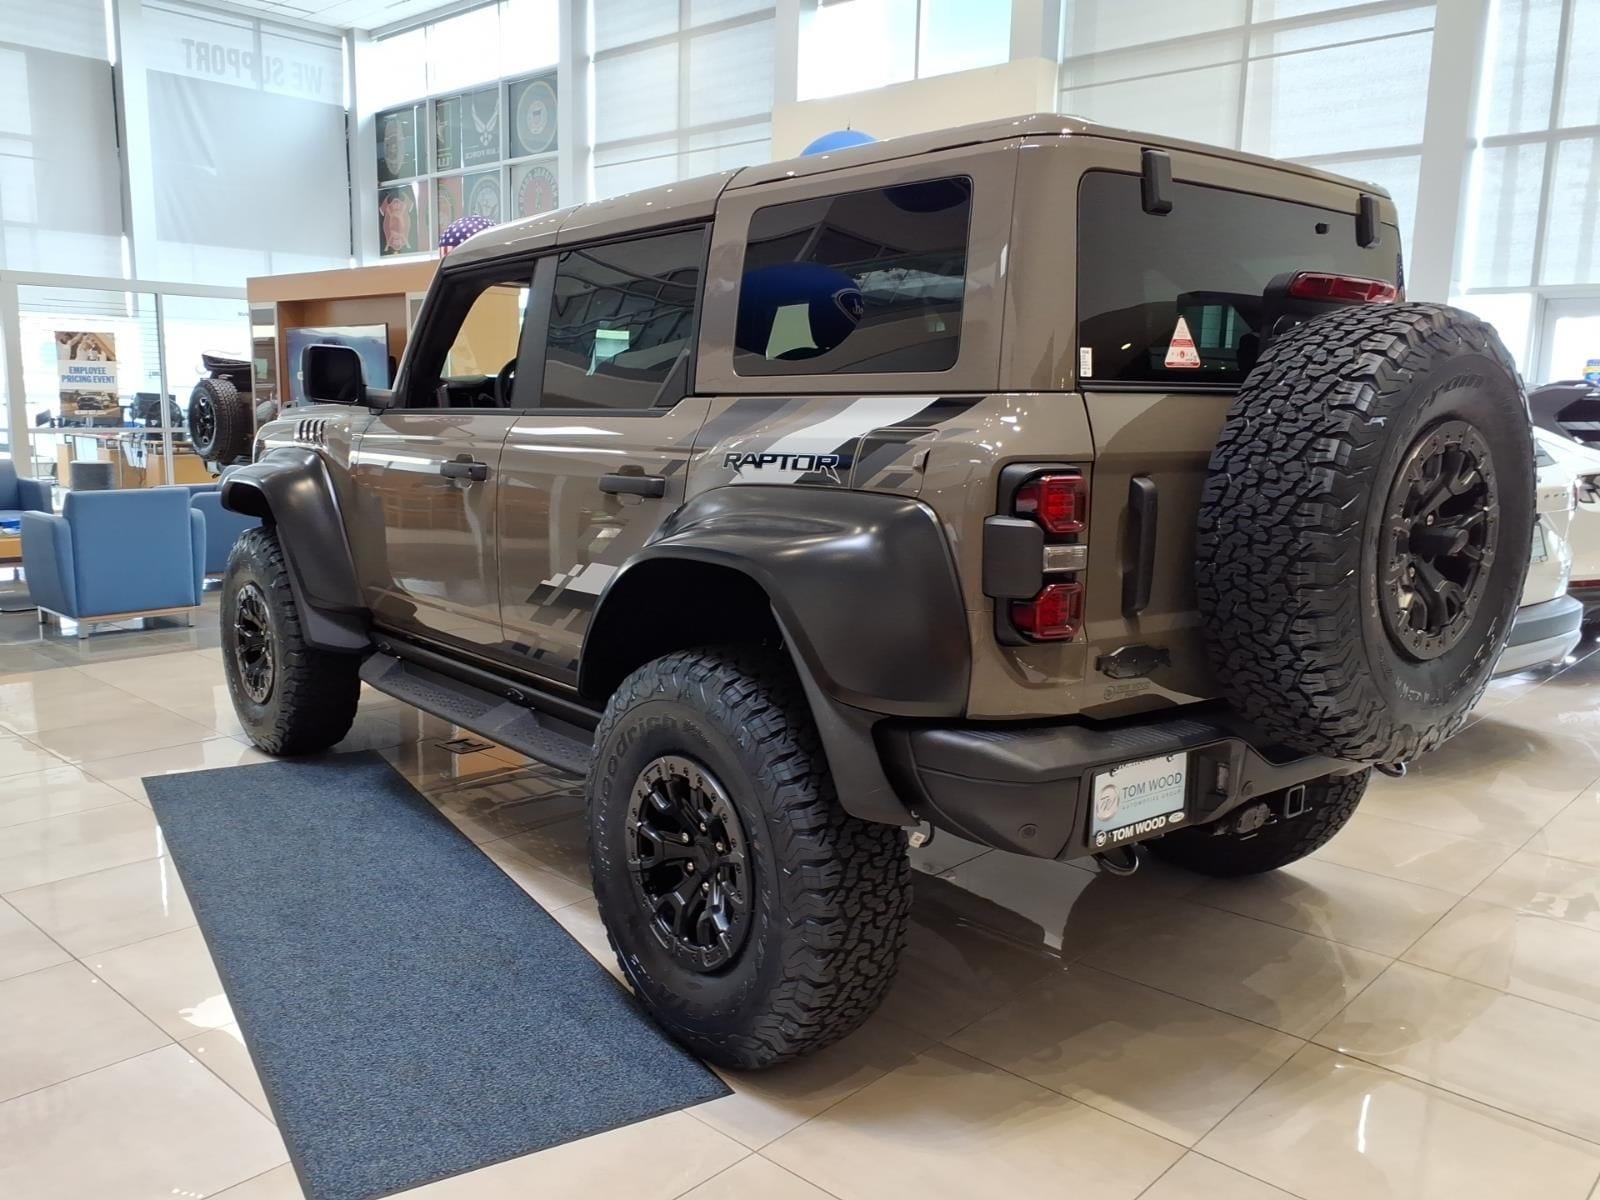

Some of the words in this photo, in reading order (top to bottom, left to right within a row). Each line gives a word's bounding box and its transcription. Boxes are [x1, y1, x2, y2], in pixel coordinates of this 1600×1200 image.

[61, 375, 93, 383] PRICING
[93, 375, 115, 384] EVENT
[68, 366, 107, 375] EMPLOYEE
[723, 452, 841, 484] RAPTOR
[1121, 781, 1146, 800] TOM
[1148, 772, 1183, 792] WOOD
[1111, 826, 1135, 842] TOM
[1135, 815, 1167, 835] WOOD
